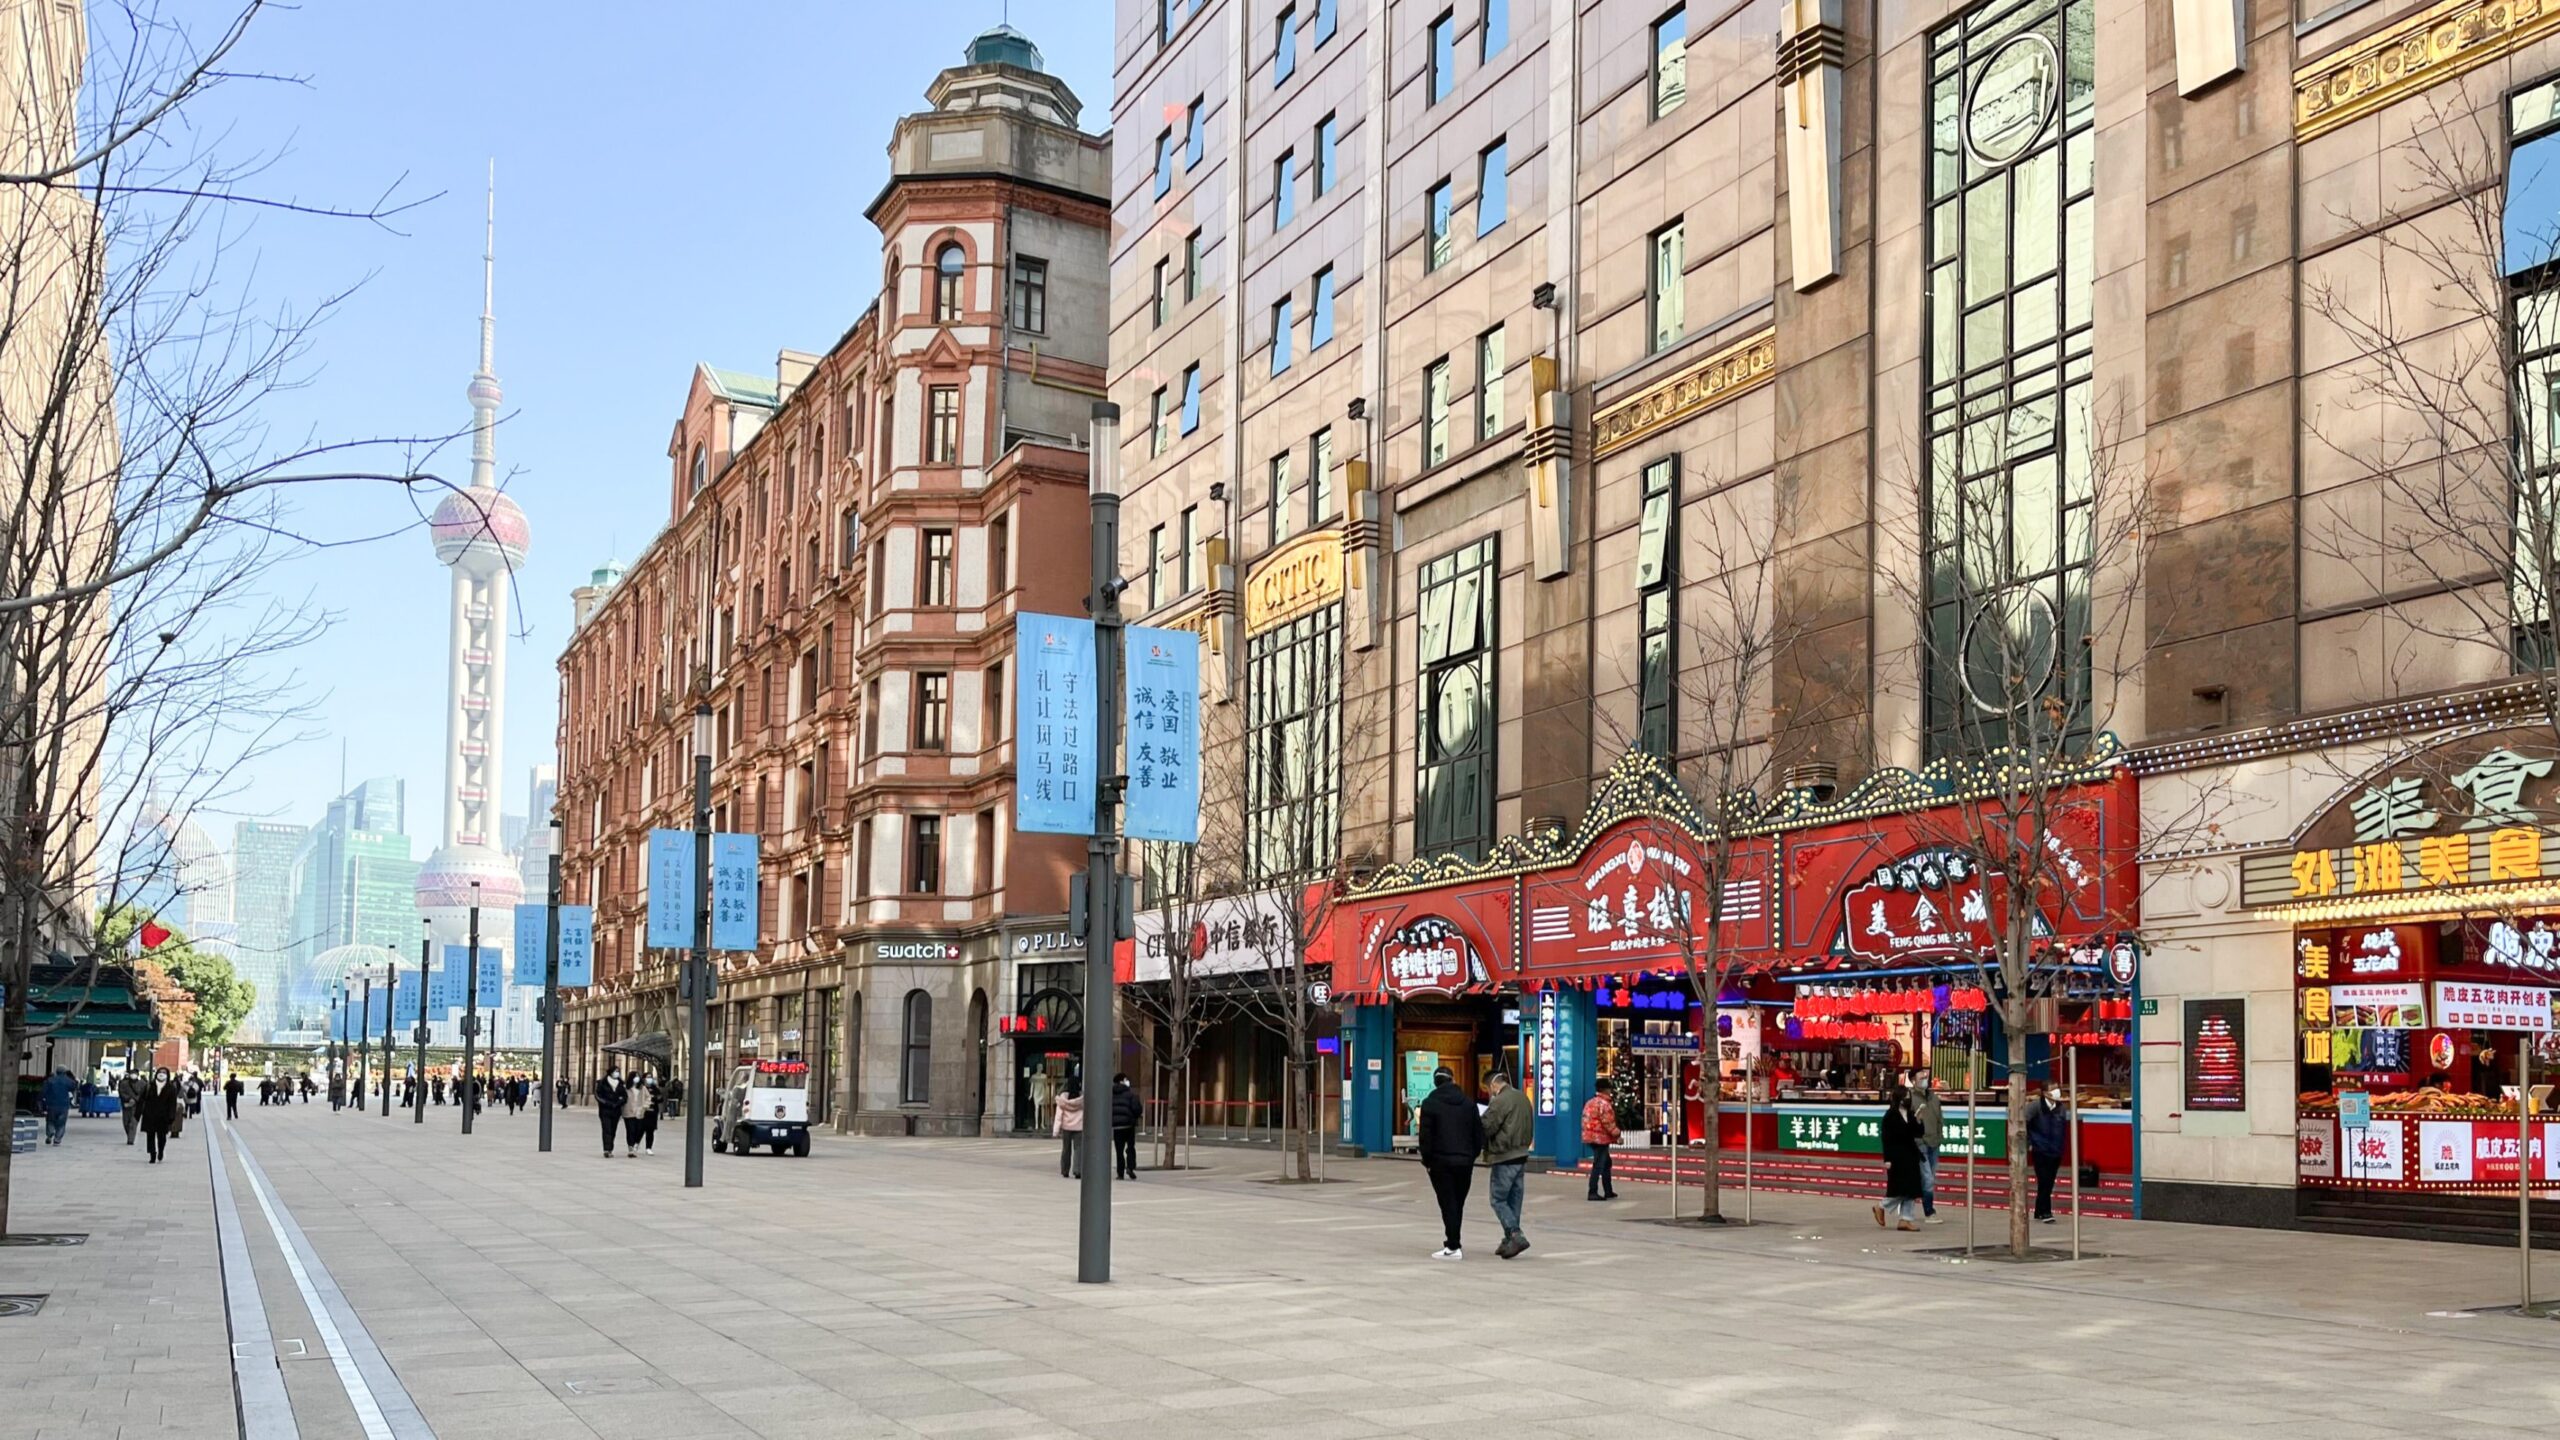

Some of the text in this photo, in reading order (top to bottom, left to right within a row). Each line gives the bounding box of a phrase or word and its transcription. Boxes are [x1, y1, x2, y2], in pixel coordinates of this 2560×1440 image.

[1264, 554, 1325, 610] CITIC
[1161, 690, 1179, 734] 爱国
[1036, 669, 1052, 801] 礼让斑马线
[1062, 672, 1079, 802] 守法过路口
[1134, 686, 1157, 788] 诚信 友善
[1160, 746, 1182, 789] 敬业
[1585, 852, 1626, 891] WANGXI
[2291, 826, 2542, 897] 外滩美食
[718, 866, 731, 922] 诚信 友善
[734, 867, 746, 922] 爱国 敬业
[877, 943, 946, 959] swatch
[1210, 913, 1278, 955] 中信银行
[1890, 937, 1912, 948] FENG
[1913, 935, 1936, 946] QING
[1937, 934, 1952, 944] ME
[2115, 949, 2132, 973] 喜
[2352, 954, 2399, 973] 五花肉
[2144, 1001, 2153, 1009] 61
[2305, 945, 2330, 1064] 美食城
[2444, 986, 2546, 1007] 脆皮五花肉开创者
[1790, 1116, 1841, 1140] 羊非羊
